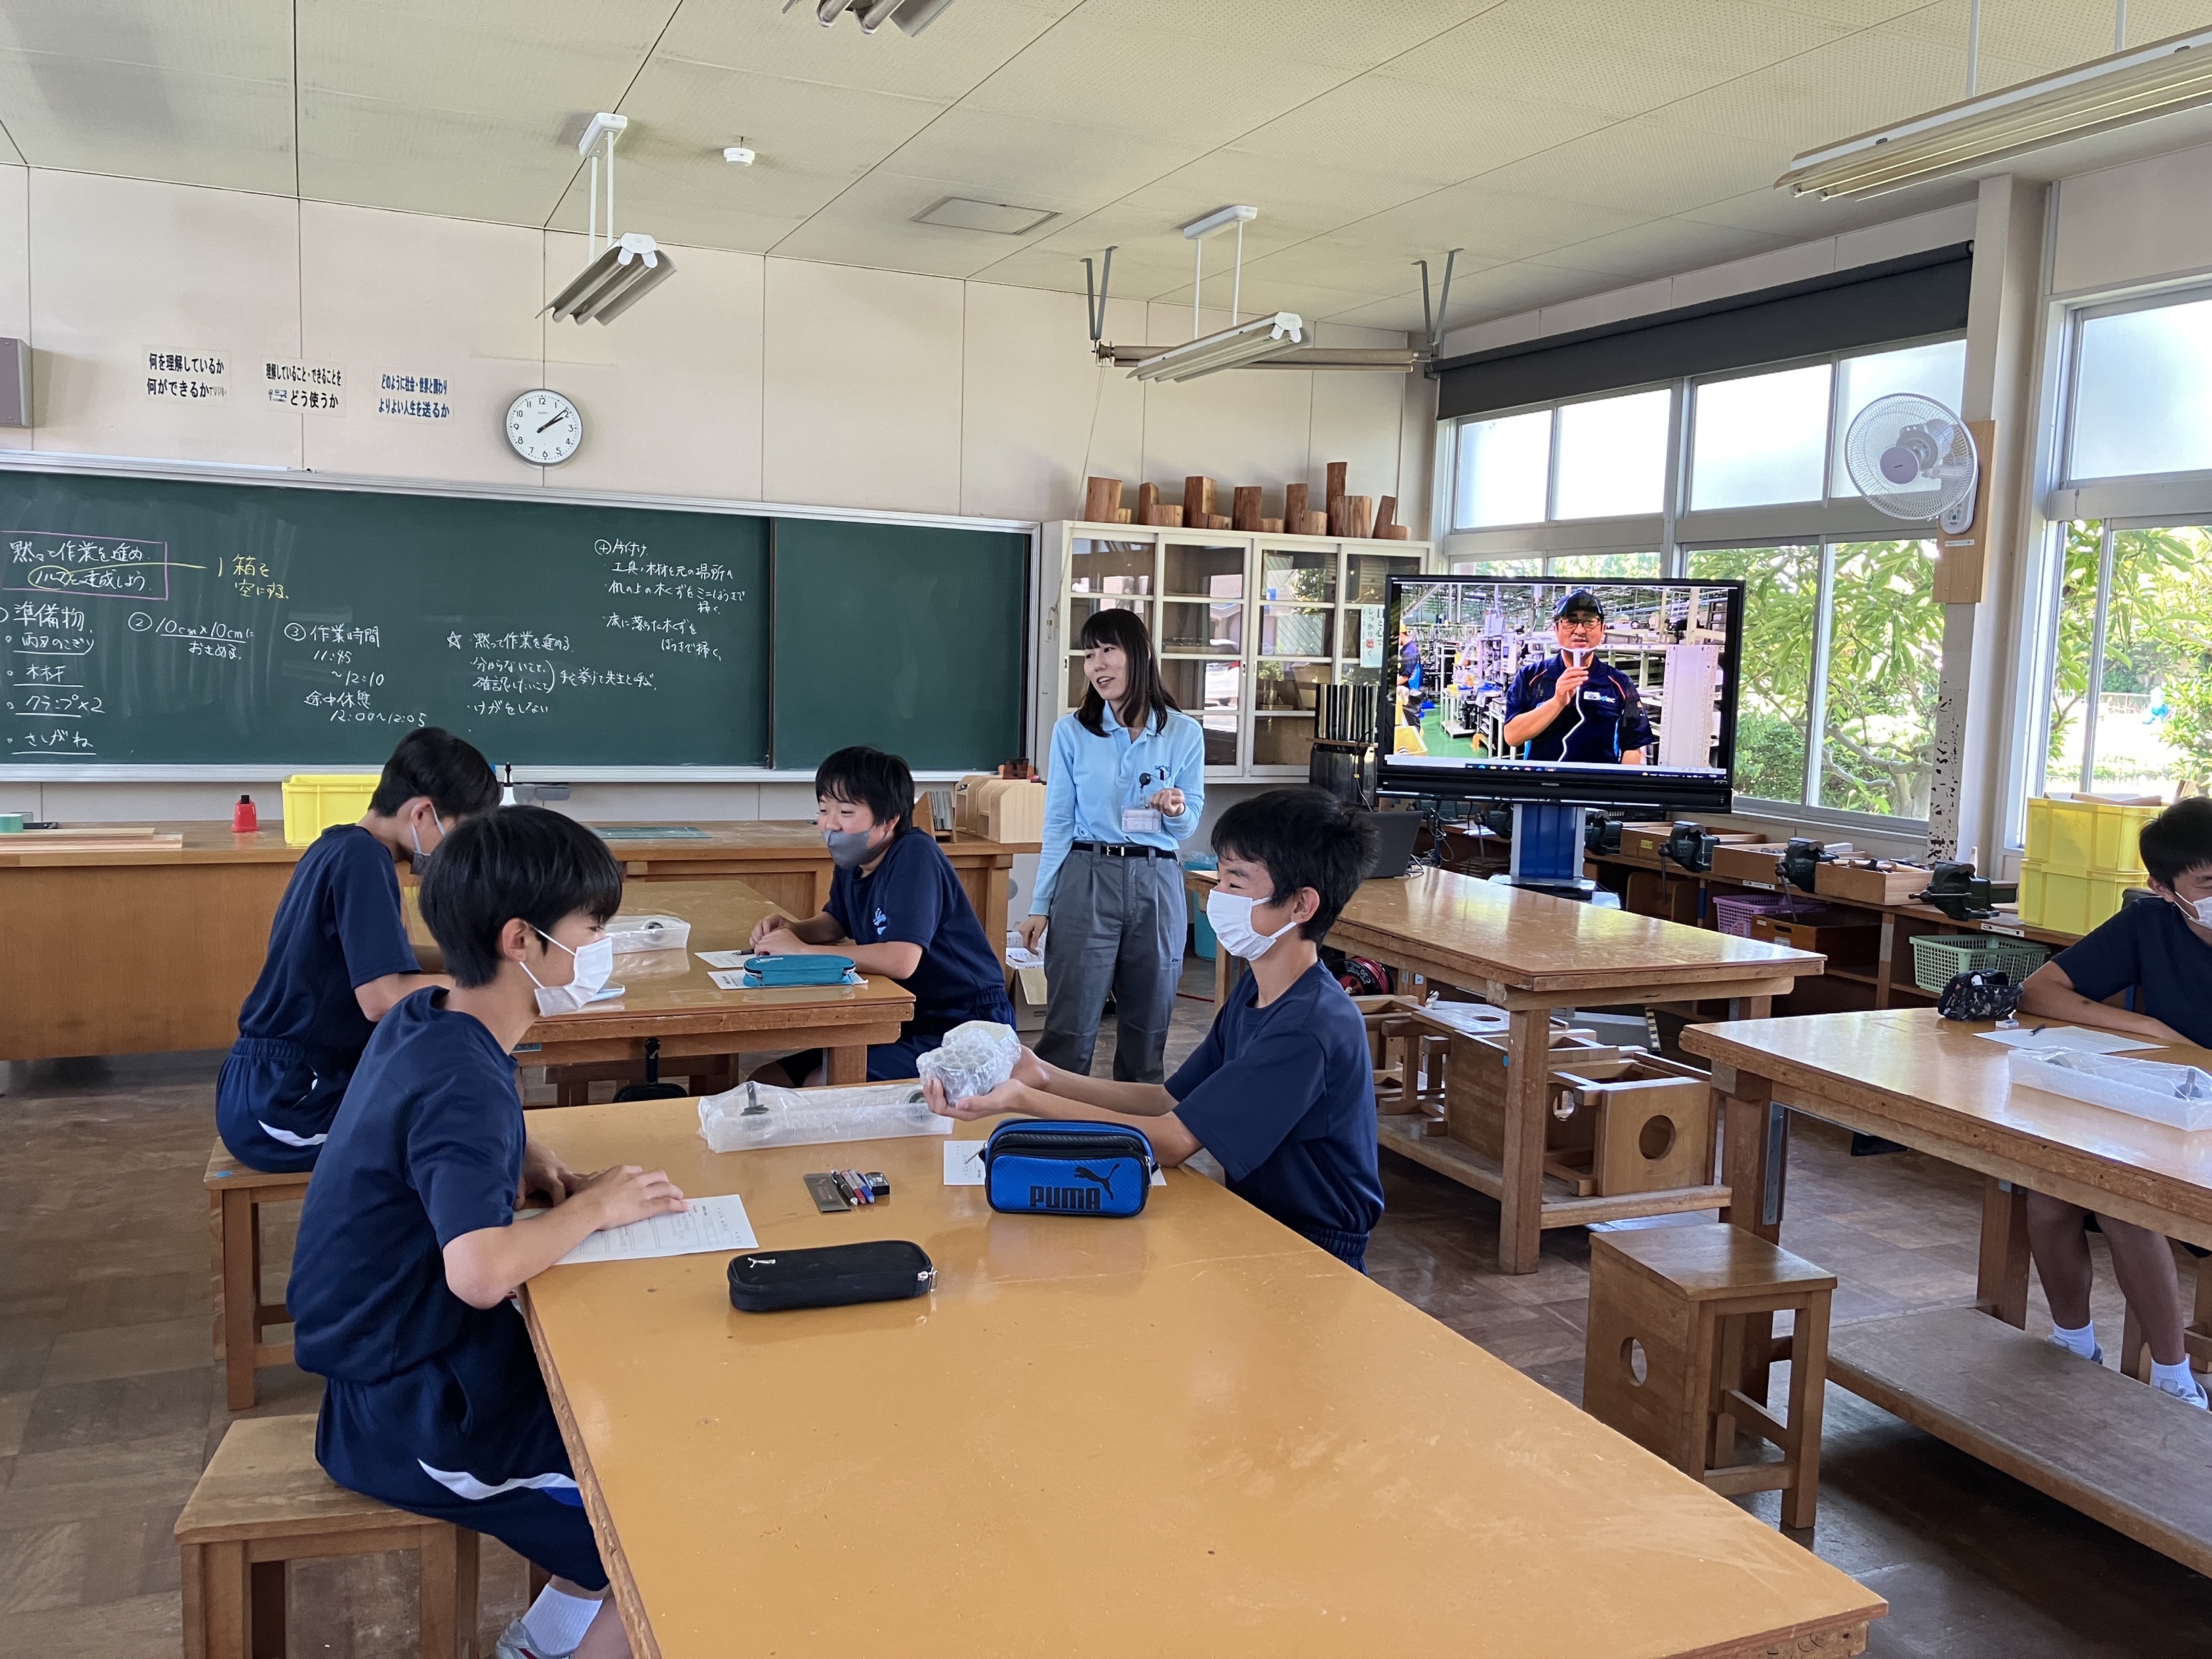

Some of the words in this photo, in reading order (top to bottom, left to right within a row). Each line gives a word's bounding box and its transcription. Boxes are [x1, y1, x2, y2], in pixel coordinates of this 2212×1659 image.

[149, 352, 224, 374] 何を理解しているか
[378, 397, 450, 418] よりよい人生を送るか
[539, 397, 546, 405] 12
[568, 424, 573, 432] 3
[517, 436, 523, 445] 8
[313, 649, 352, 665] 11:45
[26, 663, 66, 682] 木材
[474, 701, 548, 716] けがをしない
[24, 729, 94, 747] さしがね
[1029, 1185, 1101, 1210] PUMA
